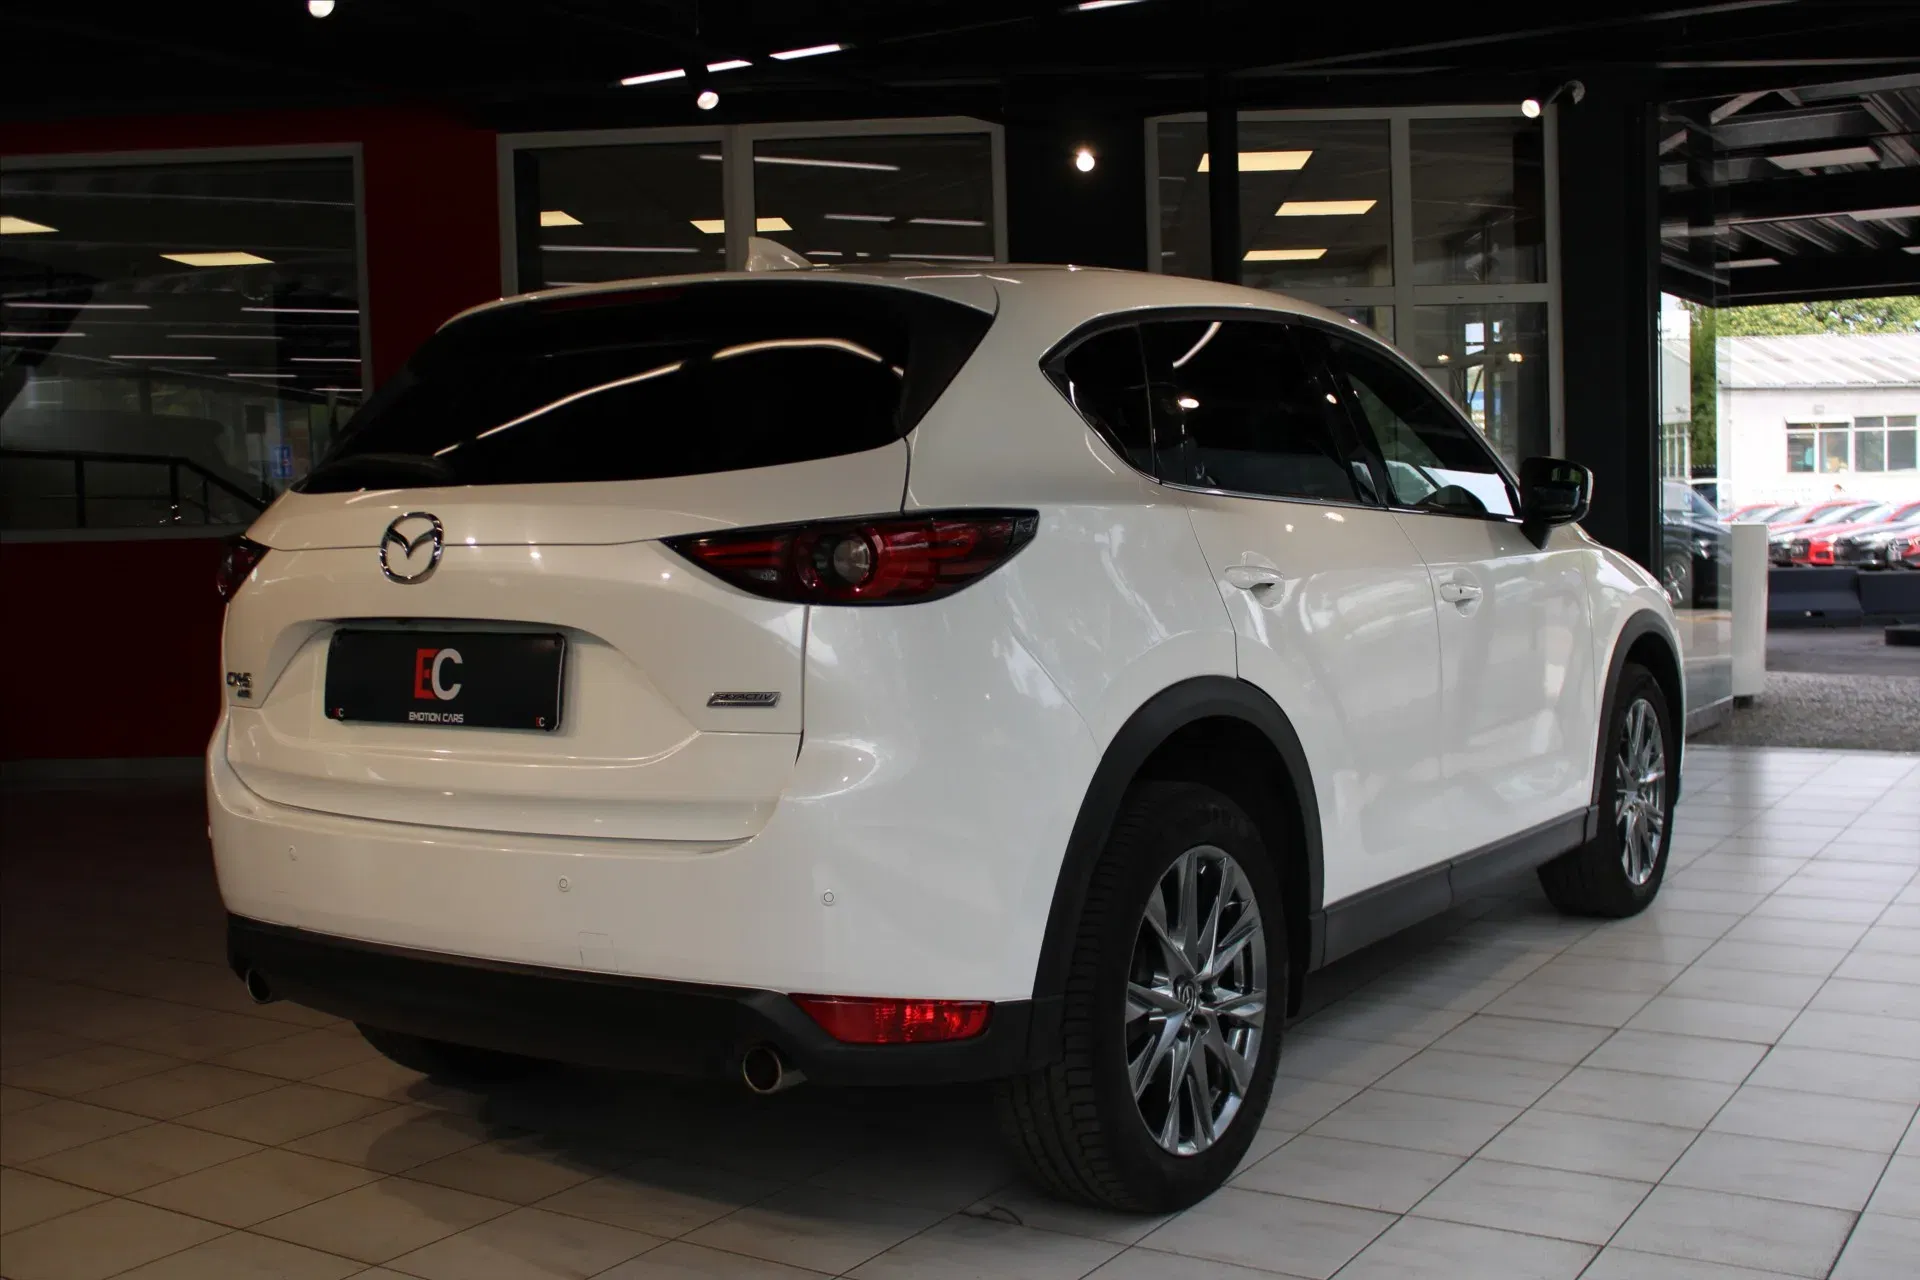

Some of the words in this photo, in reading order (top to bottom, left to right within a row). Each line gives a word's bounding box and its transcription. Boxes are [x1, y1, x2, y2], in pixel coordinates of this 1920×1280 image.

[414, 648, 463, 701] EC
[408, 711, 442, 722] EMOTION
[442, 712, 464, 723] CARS
